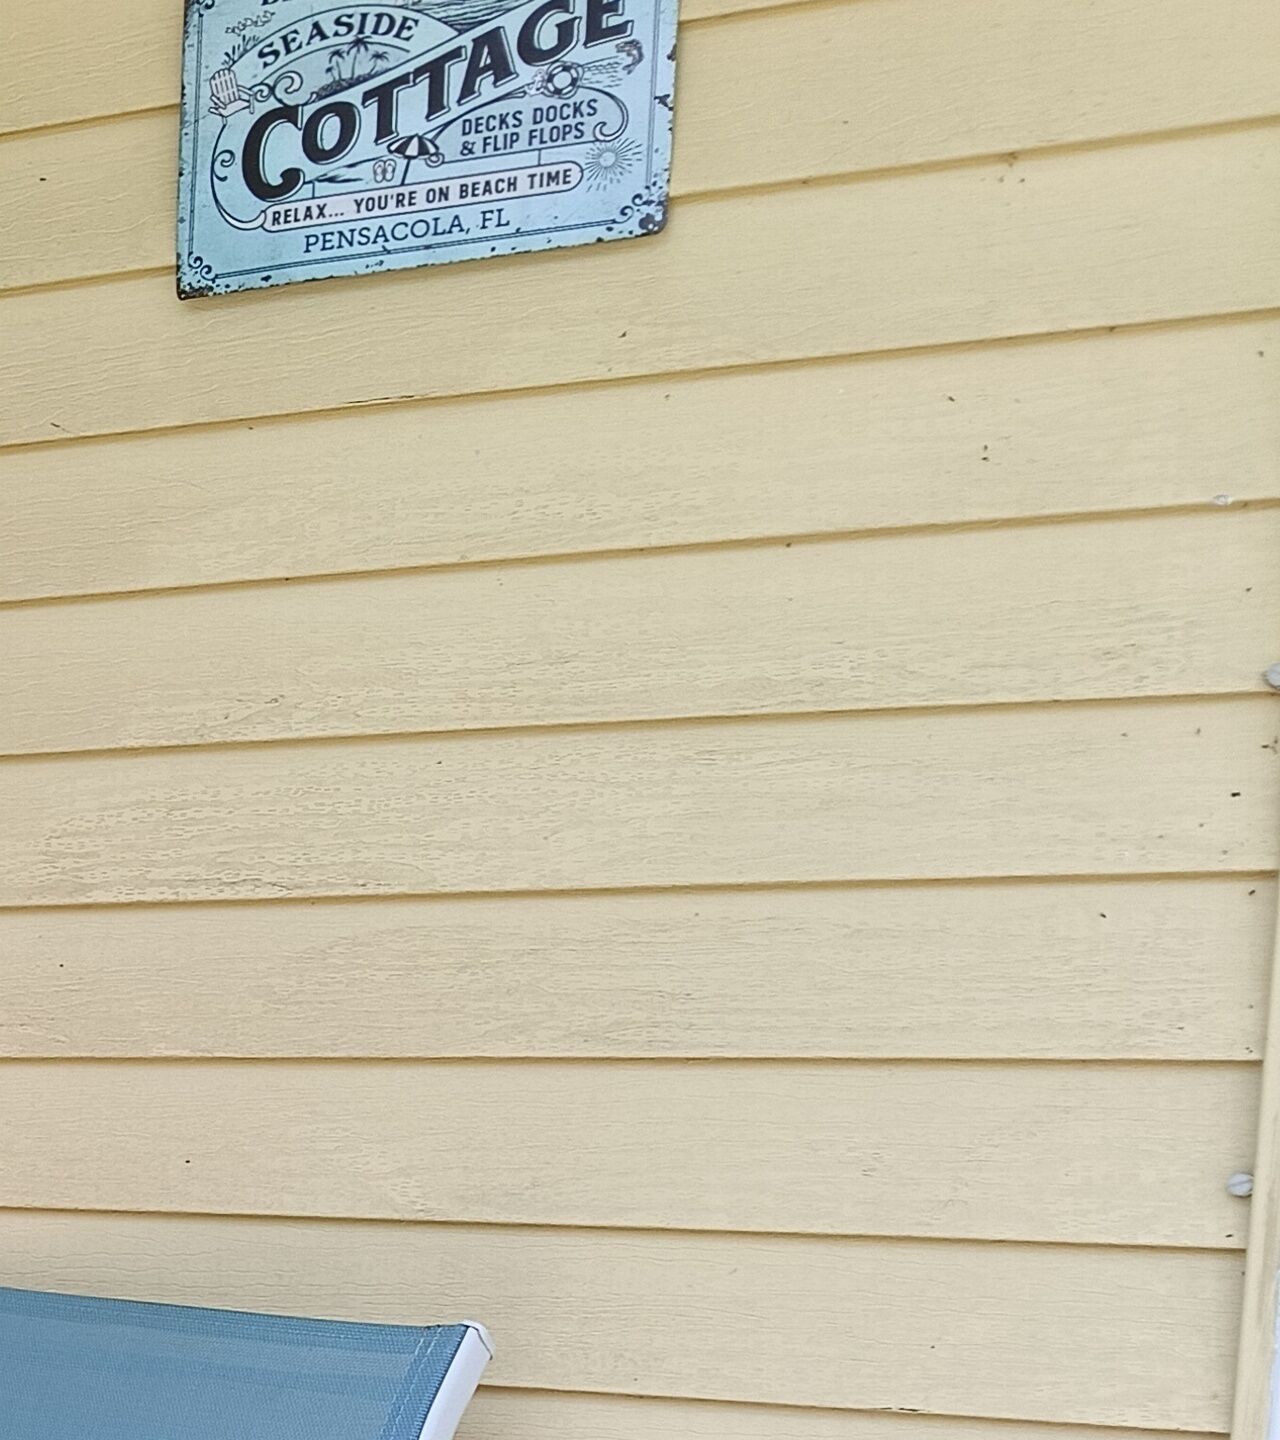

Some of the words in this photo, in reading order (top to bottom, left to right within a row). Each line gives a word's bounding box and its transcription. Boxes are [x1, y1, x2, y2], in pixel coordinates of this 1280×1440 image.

[257, 12, 419, 69] SEASIDE
[241, 0, 634, 203] COTTAGE
[461, 110, 523, 136] DECKS
[532, 98, 598, 125] DOCKS
[459, 140, 476, 156] &
[482, 131, 519, 154] FLIP
[528, 122, 585, 147] FLOPS
[271, 203, 344, 226] RELAX...
[354, 190, 417, 213] YOU'RE
[426, 186, 450, 204] ON
[459, 176, 518, 199] BEACH
[528, 168, 572, 189] TIME
[303, 214, 470, 253] PENSACOLA,
[480, 208, 510, 230] FL
